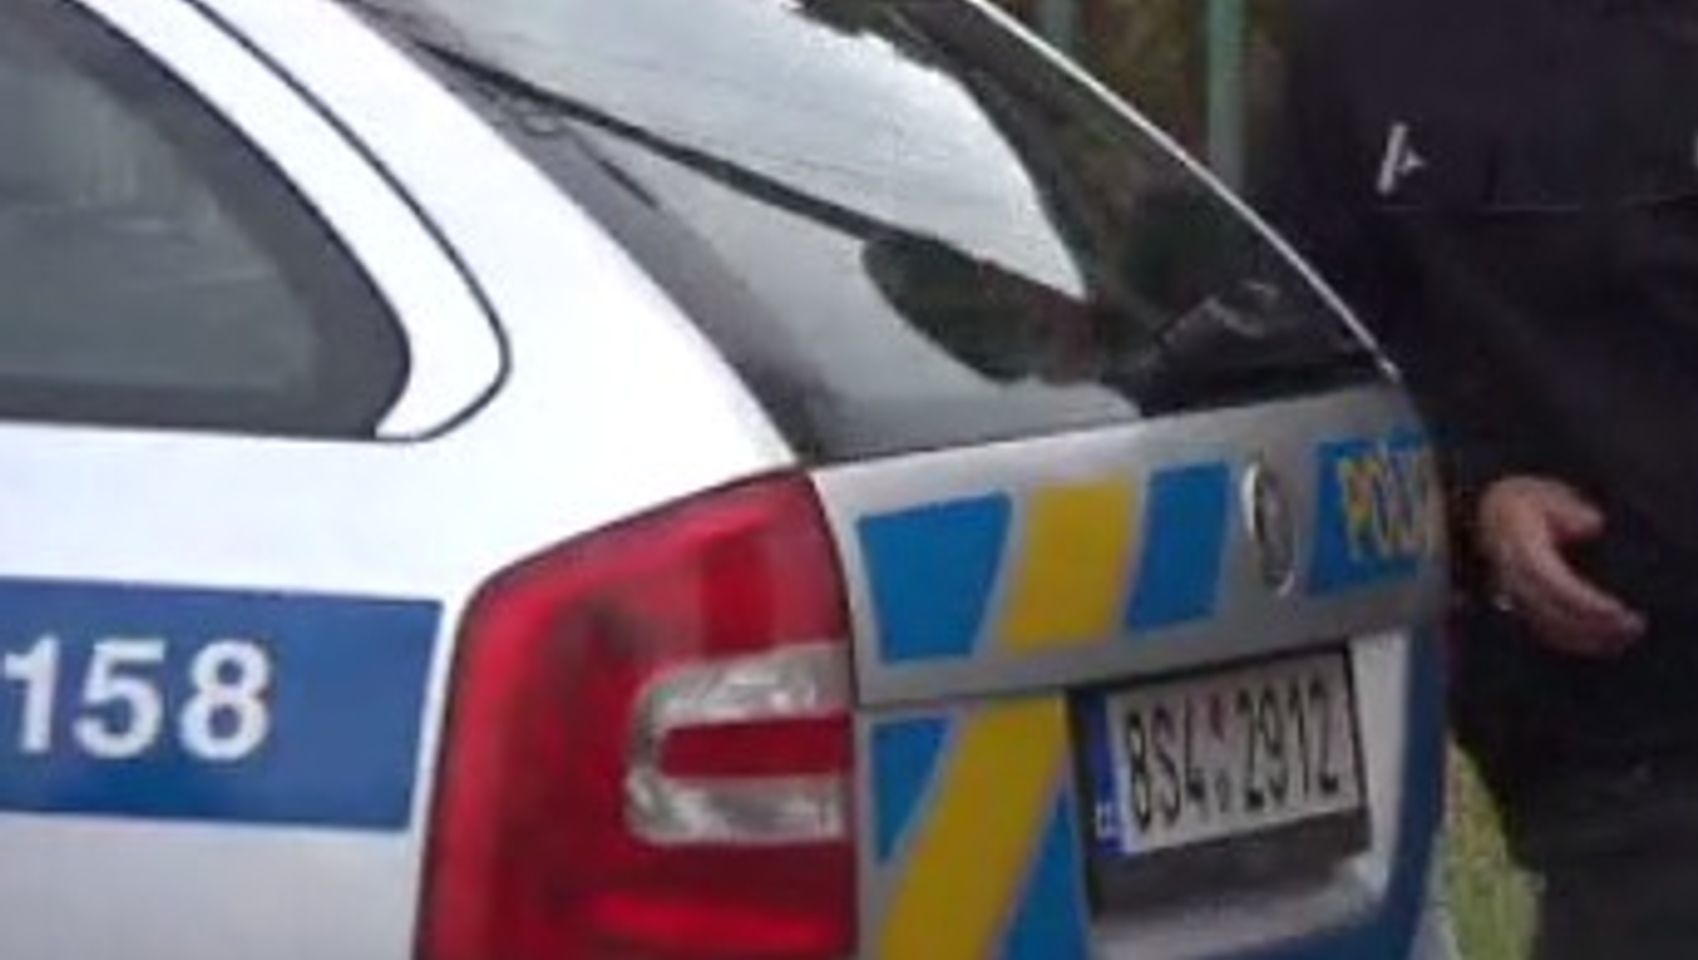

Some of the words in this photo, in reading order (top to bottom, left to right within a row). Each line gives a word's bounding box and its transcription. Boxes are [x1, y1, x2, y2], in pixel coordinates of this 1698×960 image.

[2, 635, 272, 762] 158
[1123, 693, 1208, 833] 8S4
[1235, 675, 1341, 810] 2912
